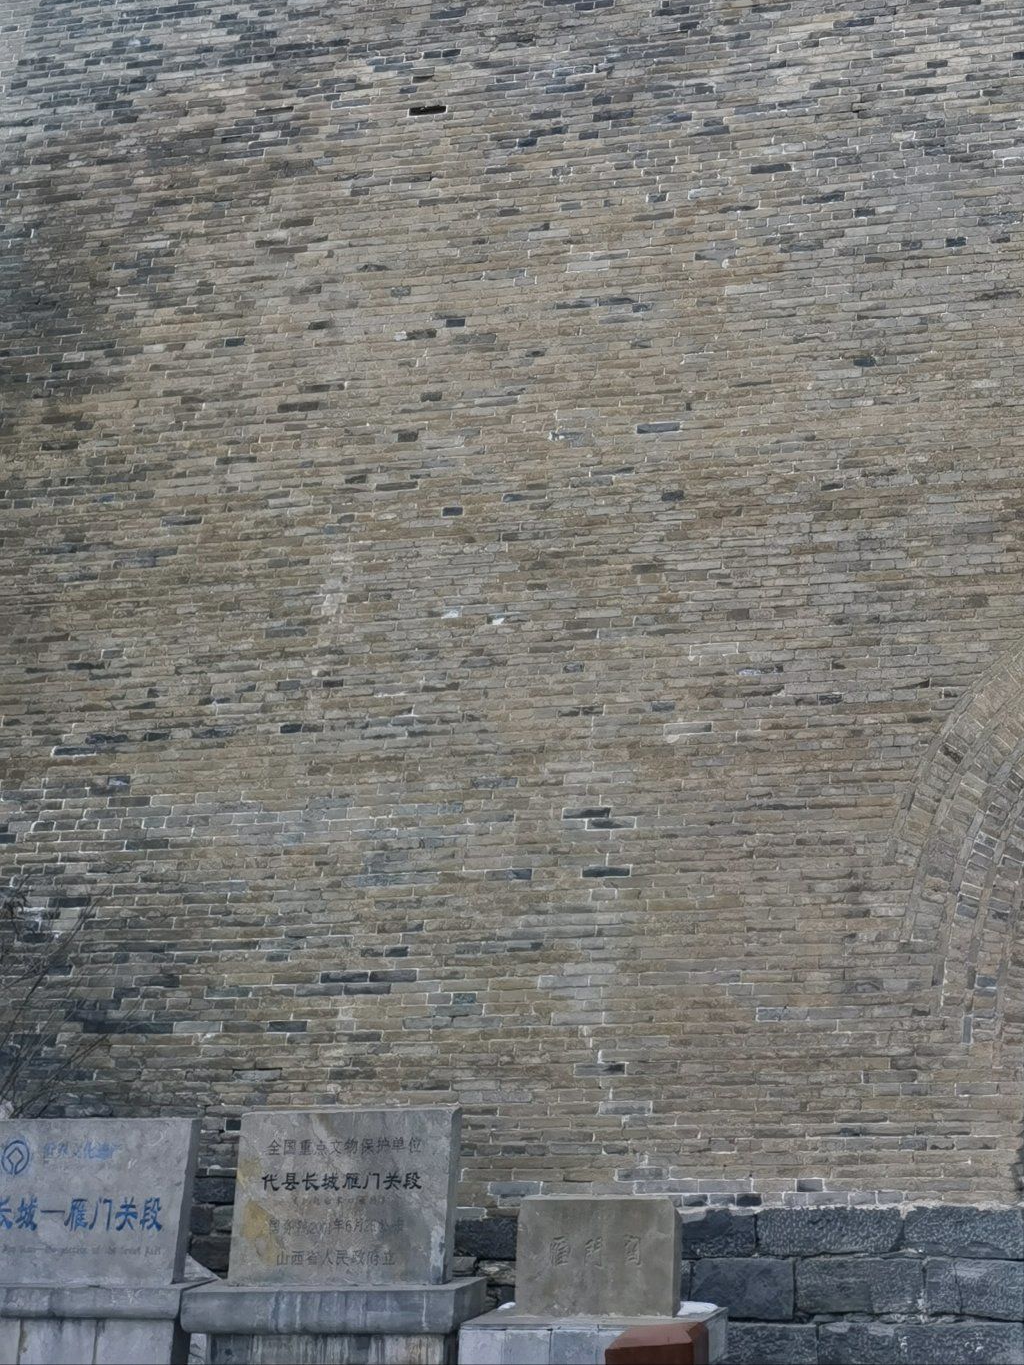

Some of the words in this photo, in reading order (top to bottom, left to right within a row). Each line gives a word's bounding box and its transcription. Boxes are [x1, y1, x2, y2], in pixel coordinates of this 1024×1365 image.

[267, 1137, 423, 1156] 全国重点文物保护单位
[262, 1172, 423, 1191] 代县长城雁门关段
[277, 1249, 396, 1266] 山西省人民政府立
